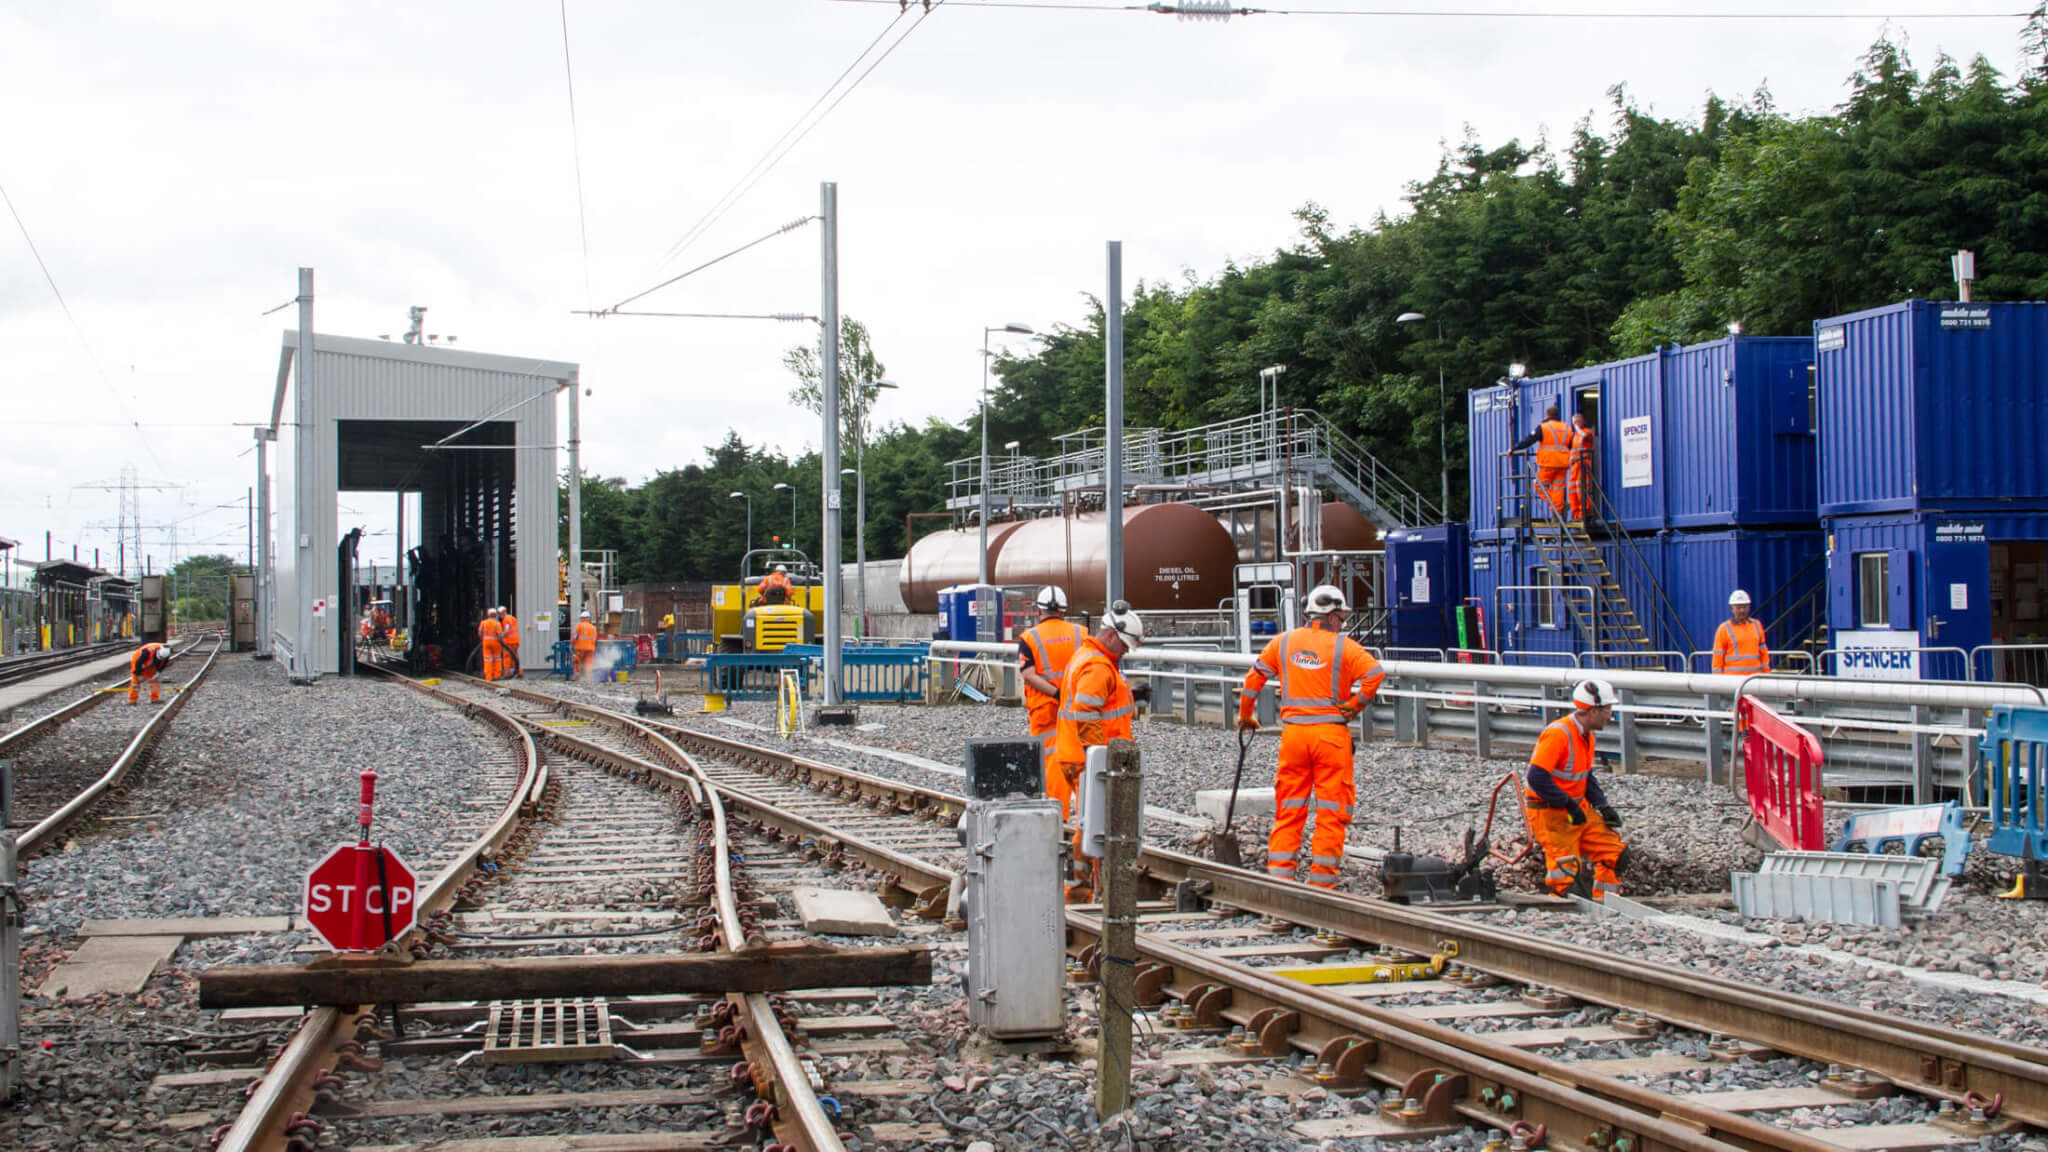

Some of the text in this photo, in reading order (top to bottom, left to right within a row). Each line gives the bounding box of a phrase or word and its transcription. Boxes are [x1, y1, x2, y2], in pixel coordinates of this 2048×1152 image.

[1624, 424, 1648, 436] SPENCER
[1843, 646, 1912, 669] SPENCER
[310, 884, 412, 914] STOP
